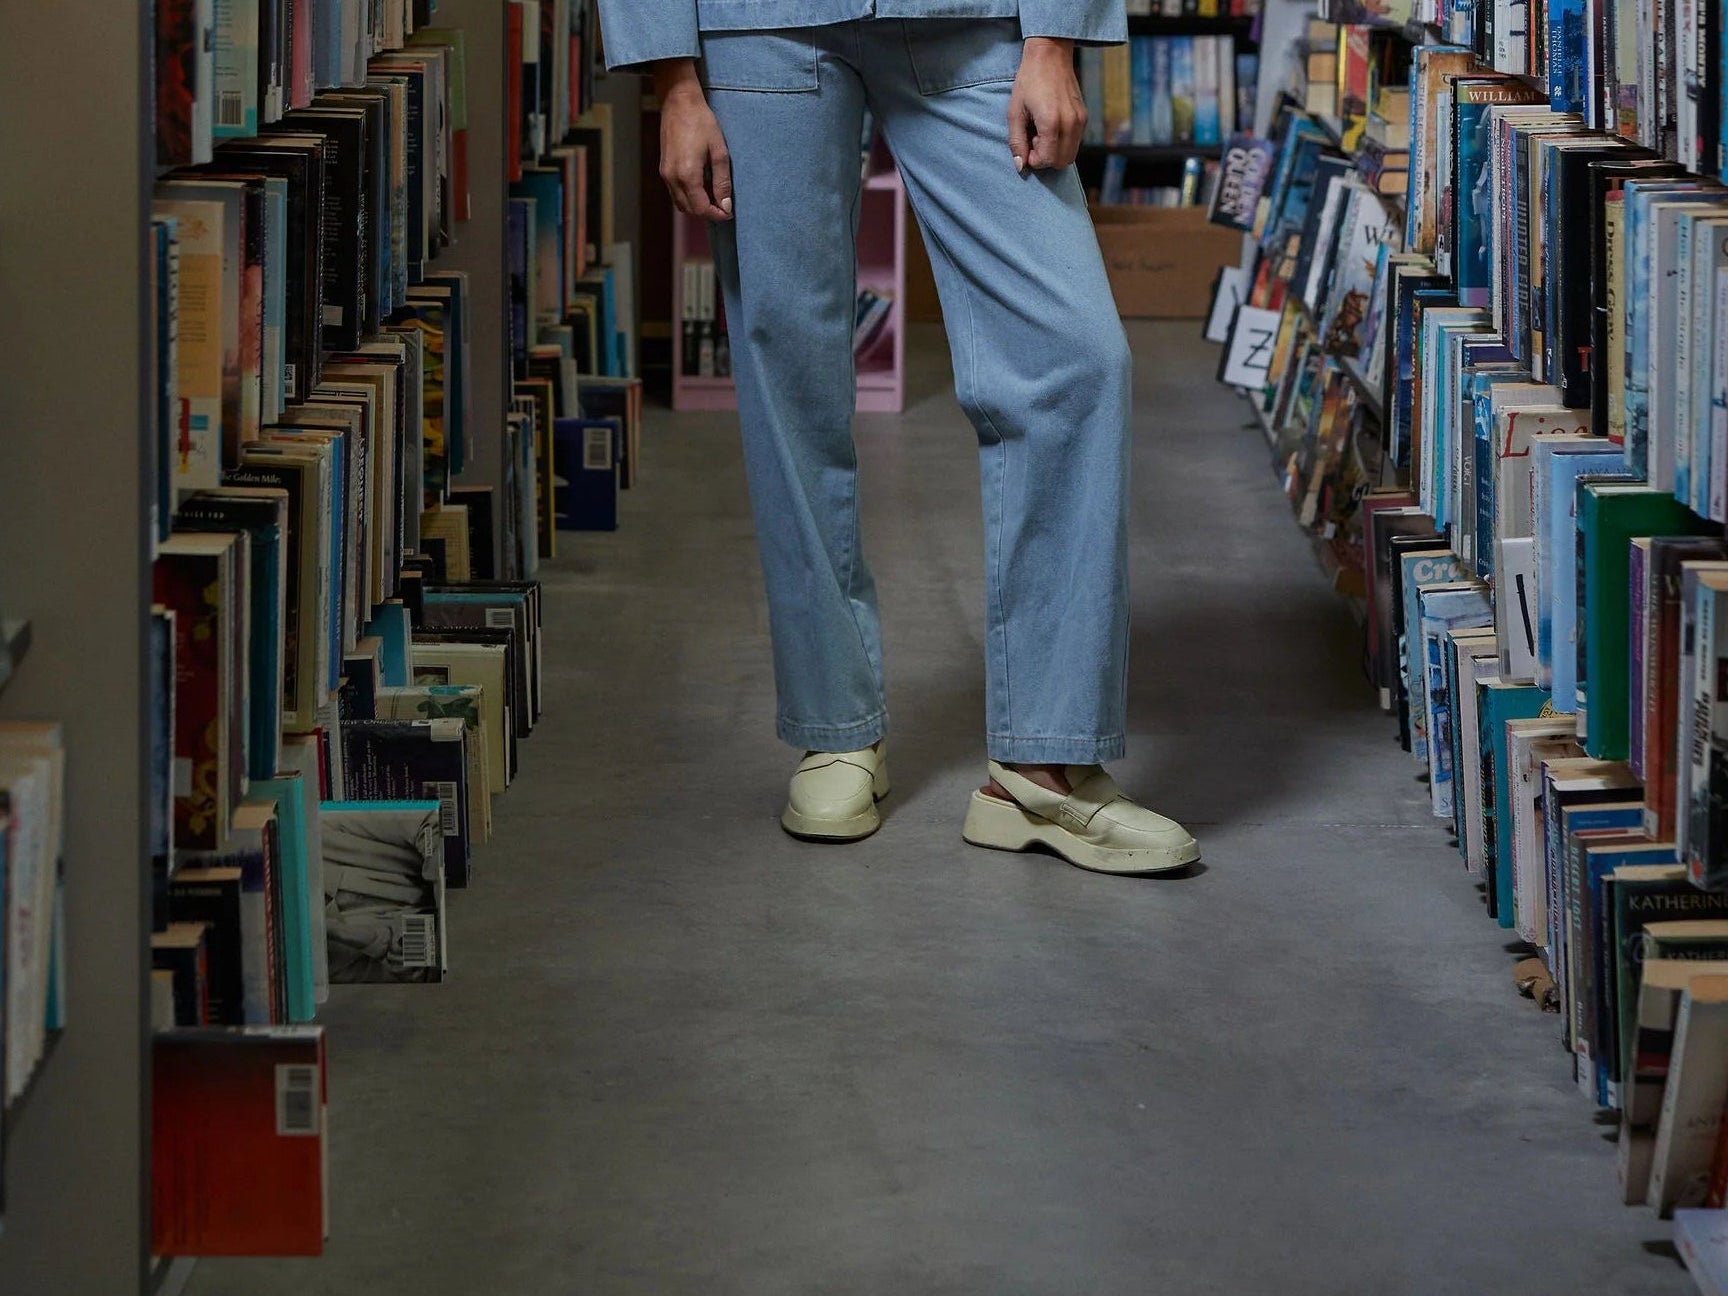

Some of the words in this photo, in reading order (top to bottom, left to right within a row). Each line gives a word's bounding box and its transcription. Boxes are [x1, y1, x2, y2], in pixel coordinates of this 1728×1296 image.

[1551, 29, 1559, 75] THOMAS
[1698, 28, 1706, 88] MONEY
[1417, 86, 1425, 109] THE
[1469, 90, 1535, 102] WILLIAM
[1416, 115, 1425, 167] SECOND
[1607, 220, 1616, 282] Dress
[1519, 273, 1529, 310] FIRE
[1243, 328, 1273, 371] Z
[1463, 454, 1472, 489] VOIGT
[1570, 845, 1581, 893] DESERT
[1572, 898, 1582, 931] LOST
